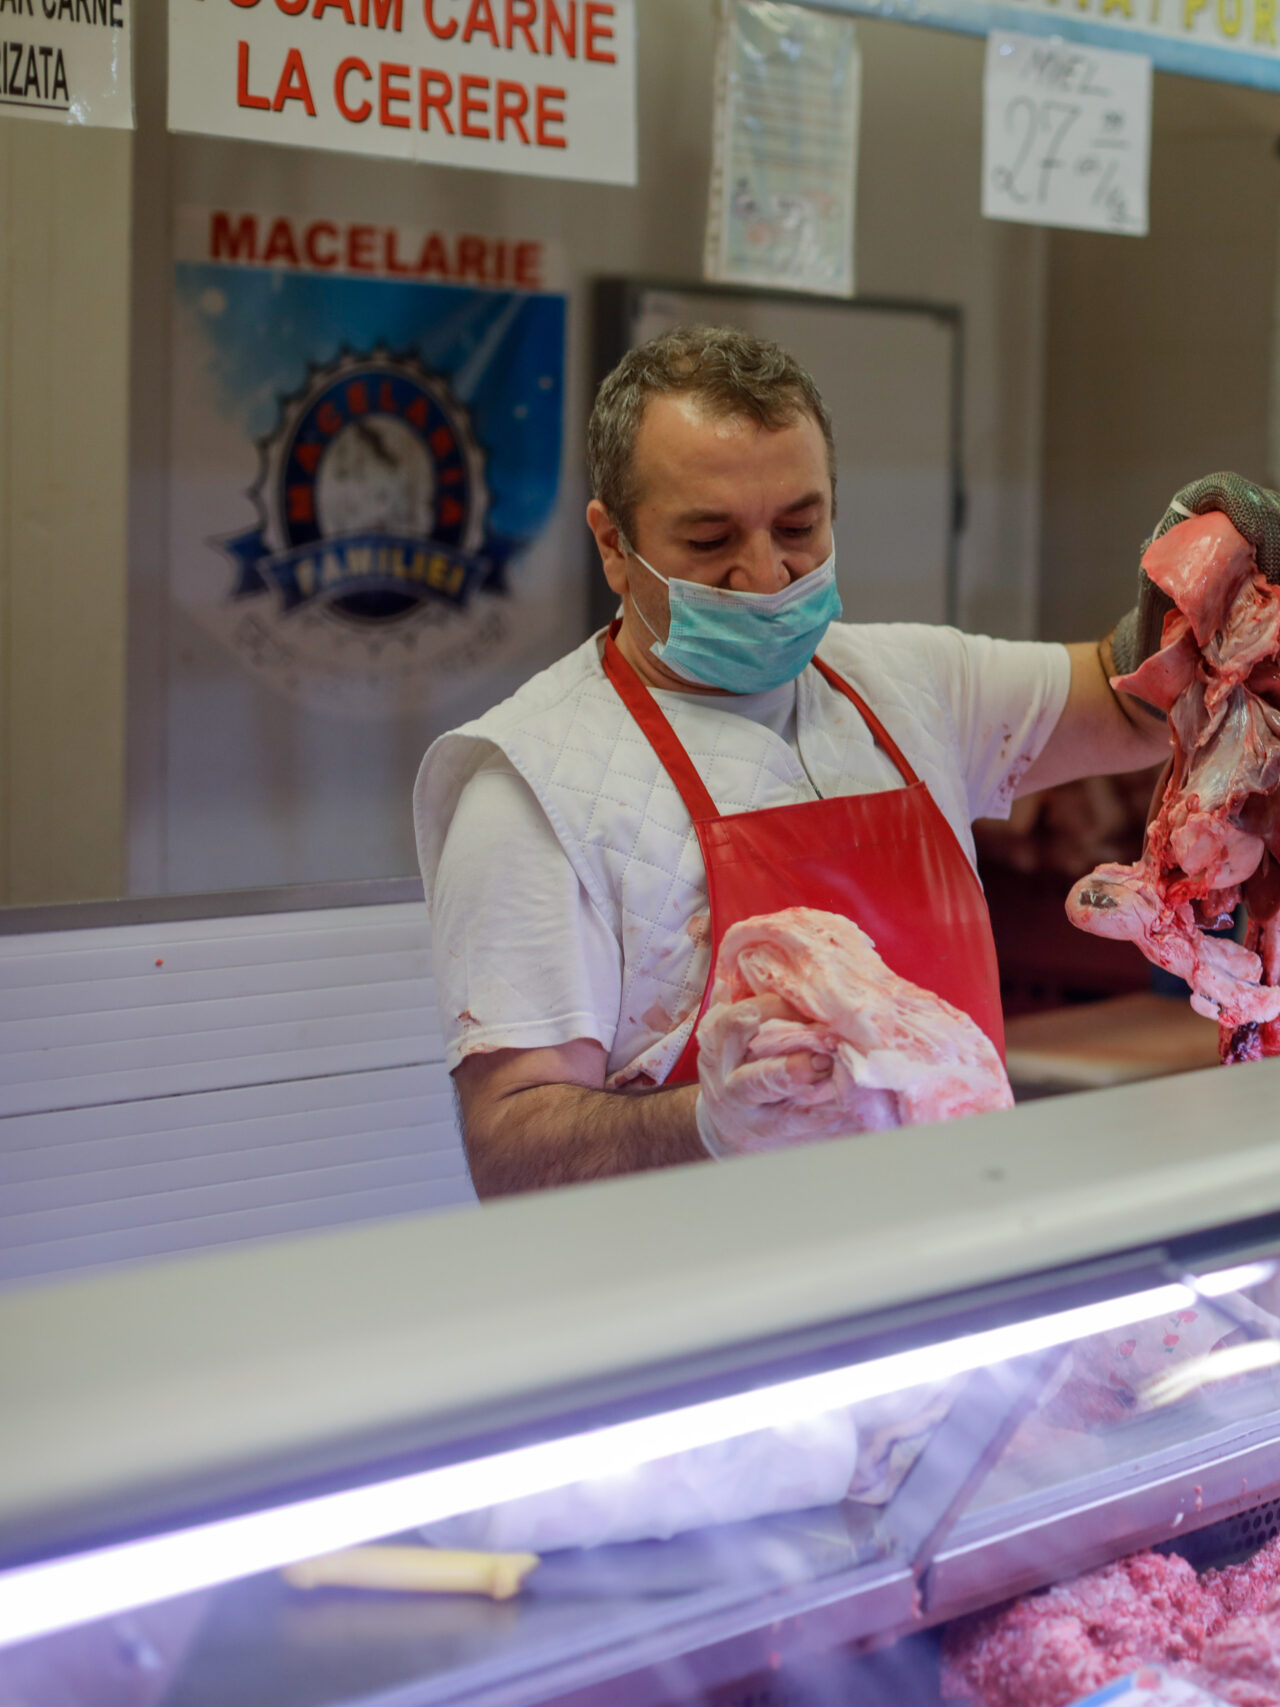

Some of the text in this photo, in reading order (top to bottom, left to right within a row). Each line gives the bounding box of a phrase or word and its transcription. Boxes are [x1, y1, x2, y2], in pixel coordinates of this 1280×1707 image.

[424, 0, 618, 64] CARNE
[0, 41, 70, 101] IZATA
[236, 40, 568, 149] LA CERERE
[208, 212, 545, 289] MACELARIE
